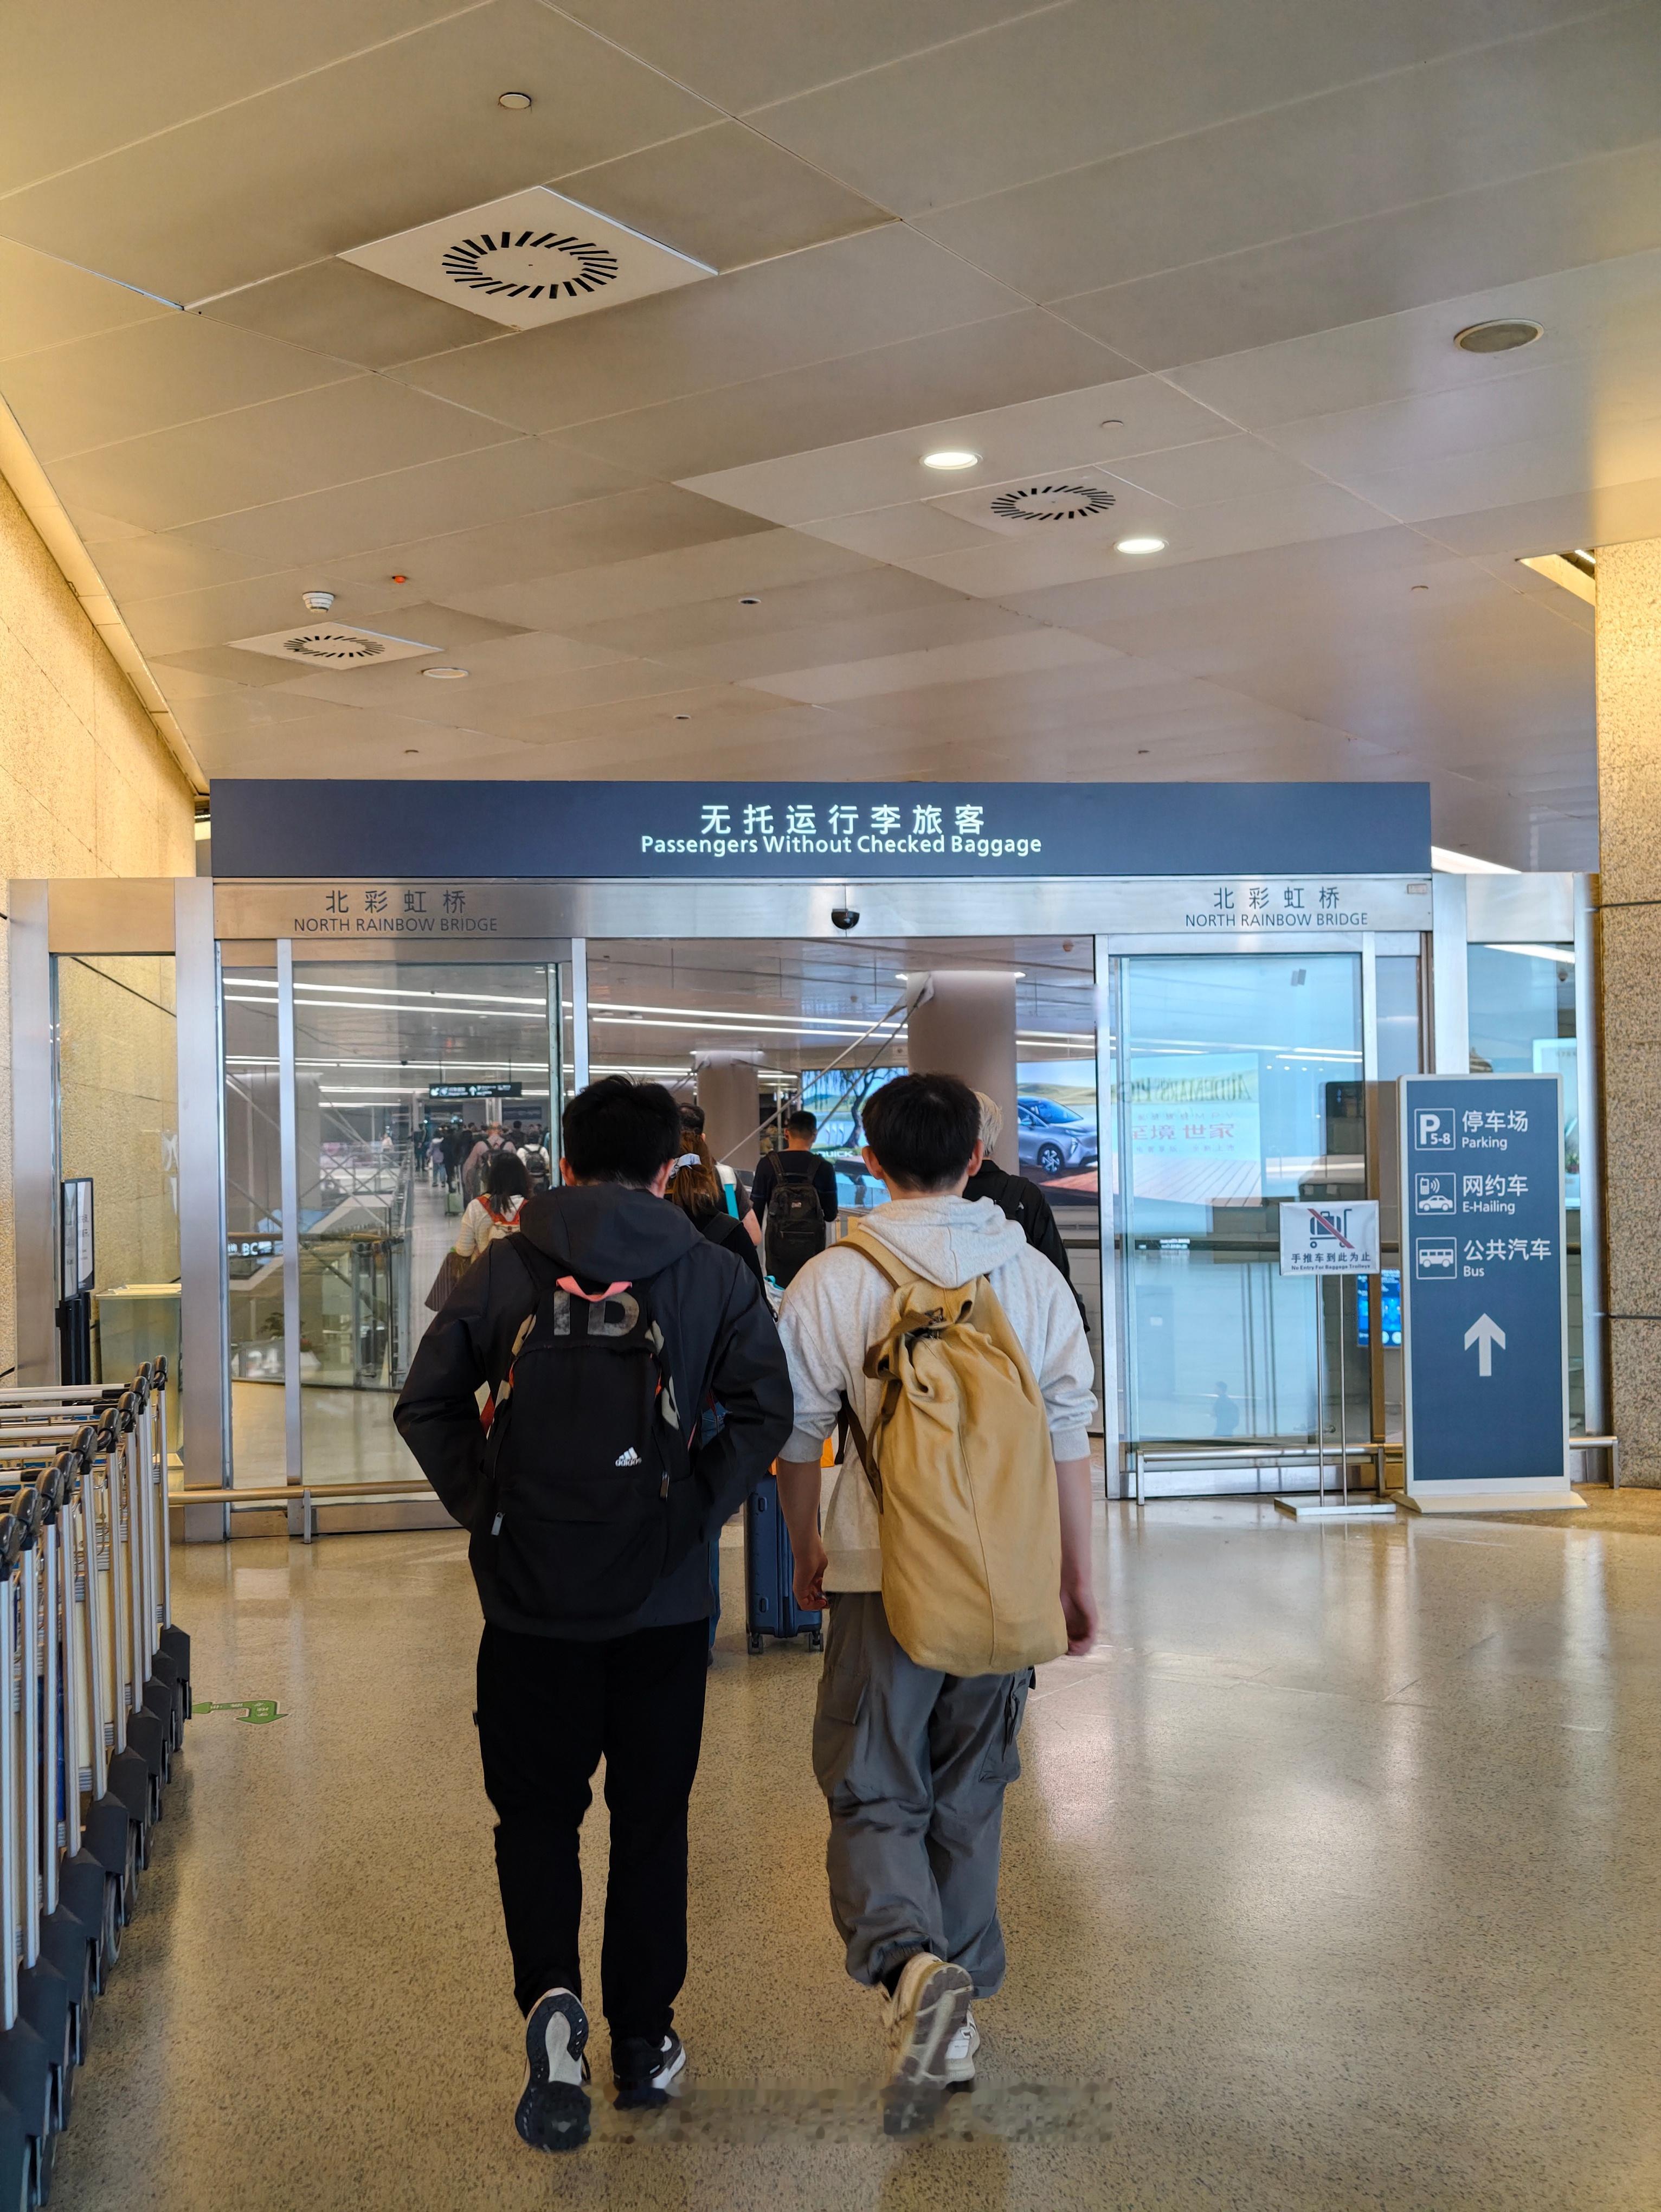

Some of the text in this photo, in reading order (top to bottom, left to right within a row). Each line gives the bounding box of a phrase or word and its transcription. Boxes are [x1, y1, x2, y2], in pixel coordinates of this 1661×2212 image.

[701, 805, 984, 834] 无托运行李旅客
[641, 835, 1041, 857] Passengers Without Checked Baggage
[325, 890, 466, 914] 北彩虹桥
[1214, 886, 1340, 910] 北彩虹桥
[294, 918, 497, 931] NORTH RAINBOW BRIDGE
[1186, 912, 1368, 927] NORTH RAINBOW BRIDGE
[1463, 1110, 1528, 1133] 停车场
[1462, 1136, 1508, 1150] Parking
[1463, 1174, 1529, 1197] 网约车
[1463, 1200, 1516, 1214] E-Hailing
[1291, 1252, 1371, 1264] 手推车到此为止
[1464, 1238, 1551, 1261] 公共汽车
[1463, 1266, 1485, 1277] Bus
